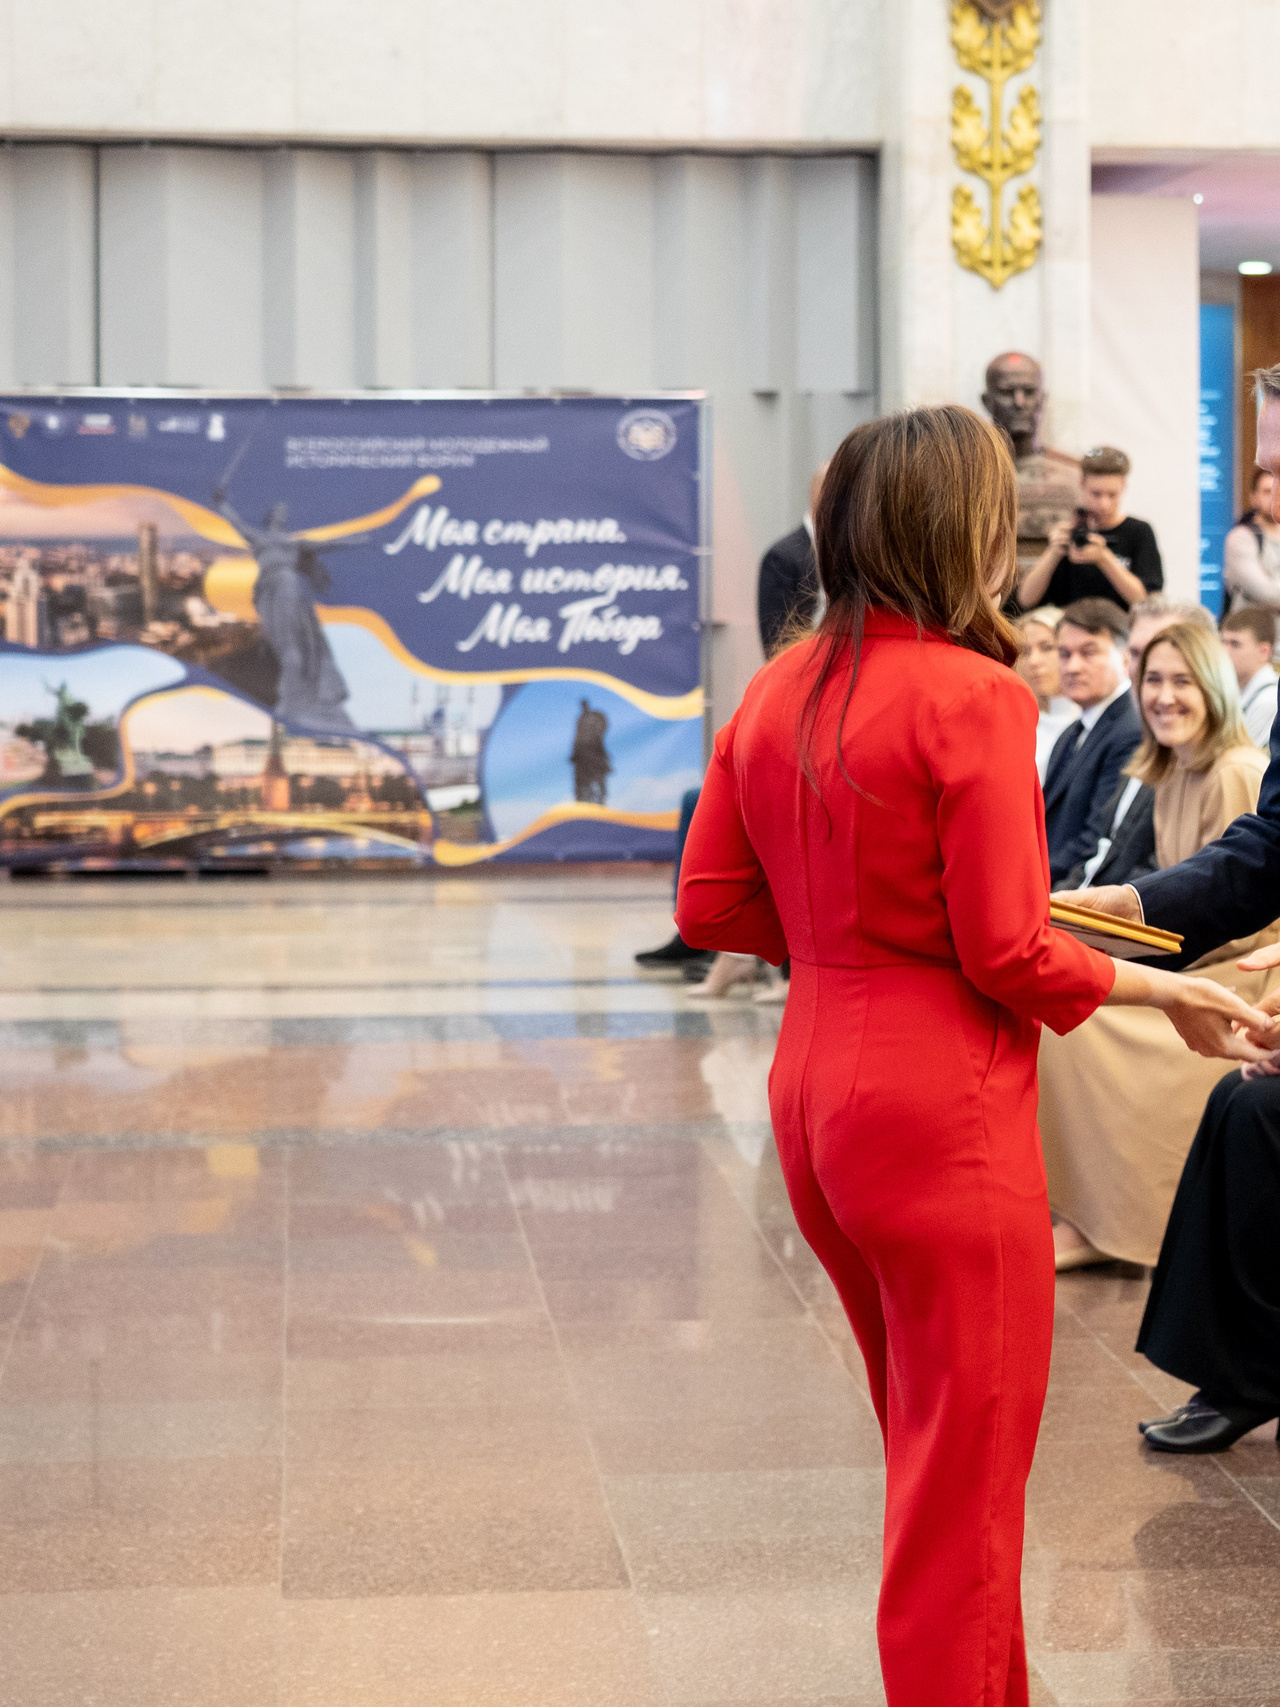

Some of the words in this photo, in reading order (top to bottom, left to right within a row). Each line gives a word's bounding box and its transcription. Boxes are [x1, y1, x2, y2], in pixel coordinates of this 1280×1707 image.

[384, 504, 479, 554] Моя
[483, 518, 627, 557] страна.
[417, 553, 513, 603] Моя
[520, 563, 689, 601] история.
[456, 601, 551, 652] Моя
[558, 597, 663, 654] Победа
